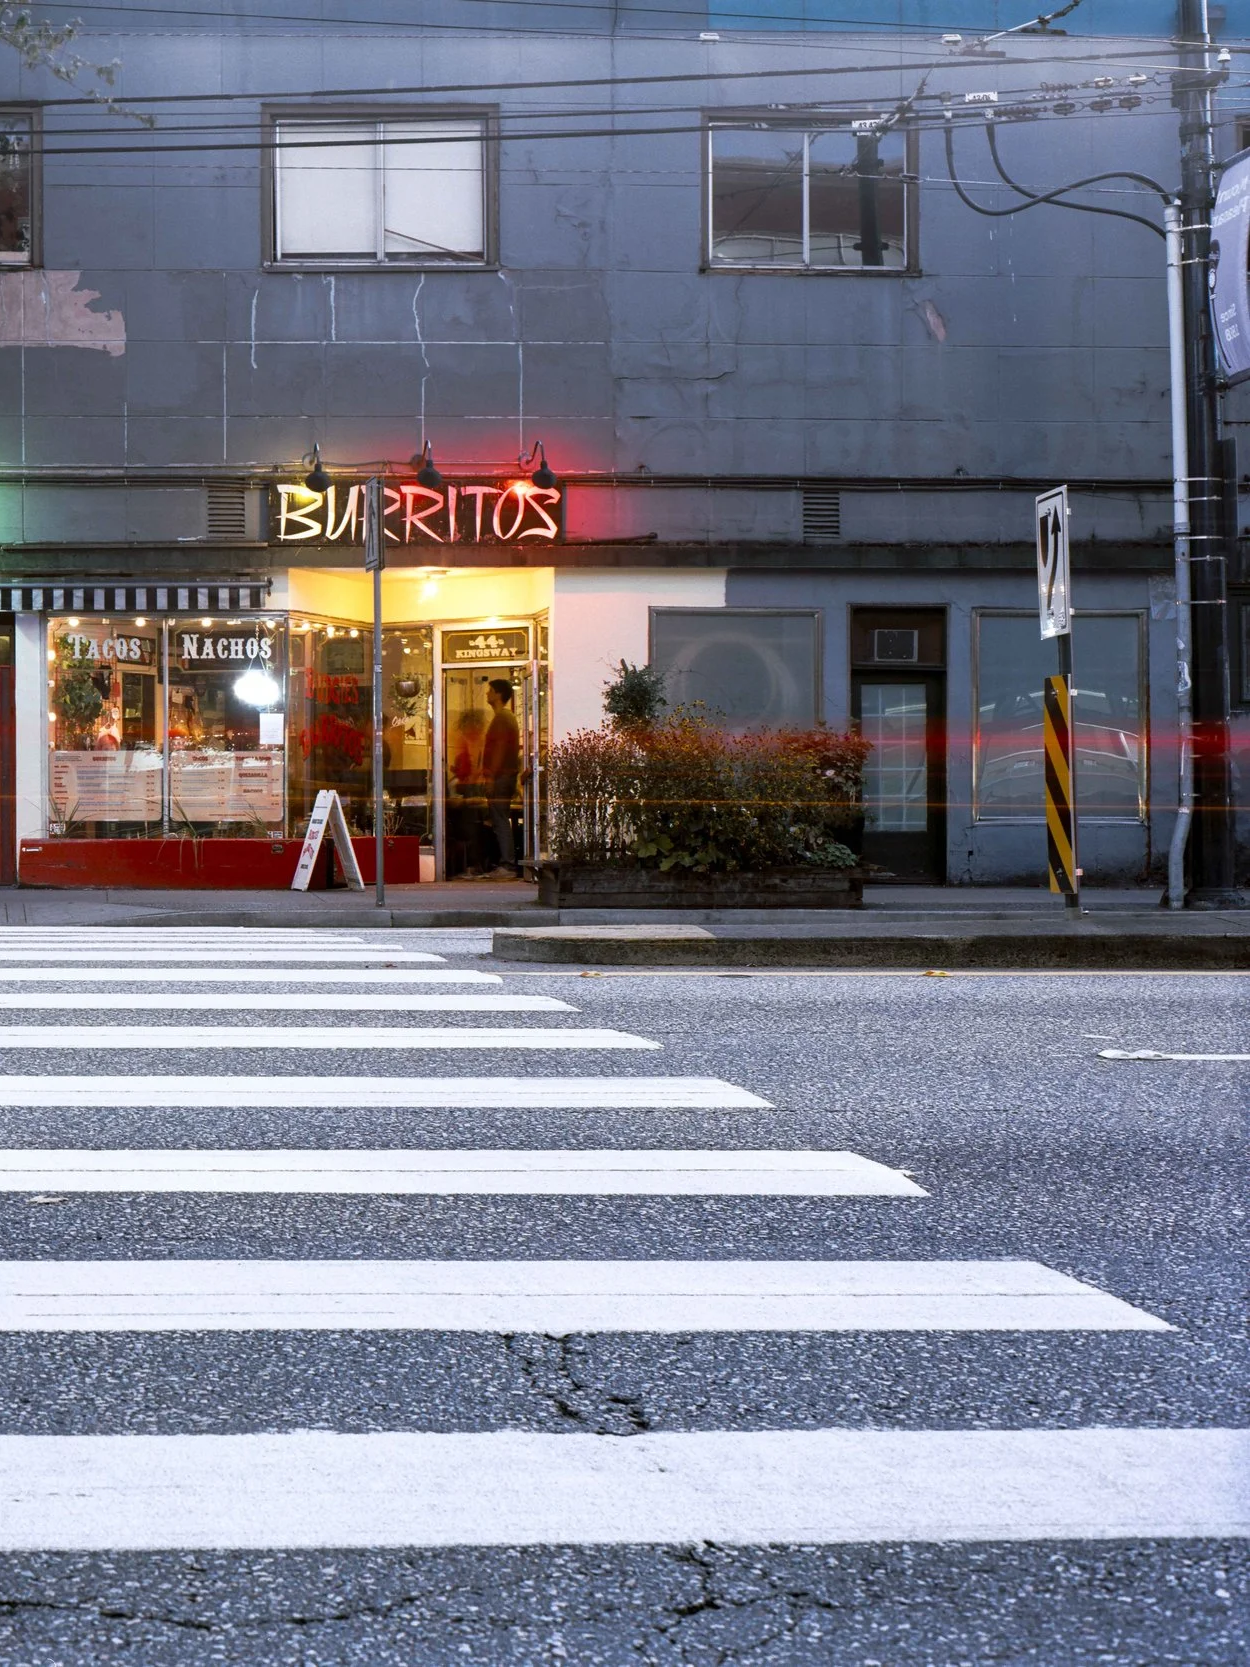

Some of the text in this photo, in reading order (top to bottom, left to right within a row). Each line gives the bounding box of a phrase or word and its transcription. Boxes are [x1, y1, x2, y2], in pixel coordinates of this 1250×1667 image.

[275, 484, 561, 544] BURRITOS
[67, 633, 142, 660] TACOS
[181, 633, 272, 660] NACHOS
[455, 647, 518, 659] KINGSWAY
[474, 634, 499, 649] 44
